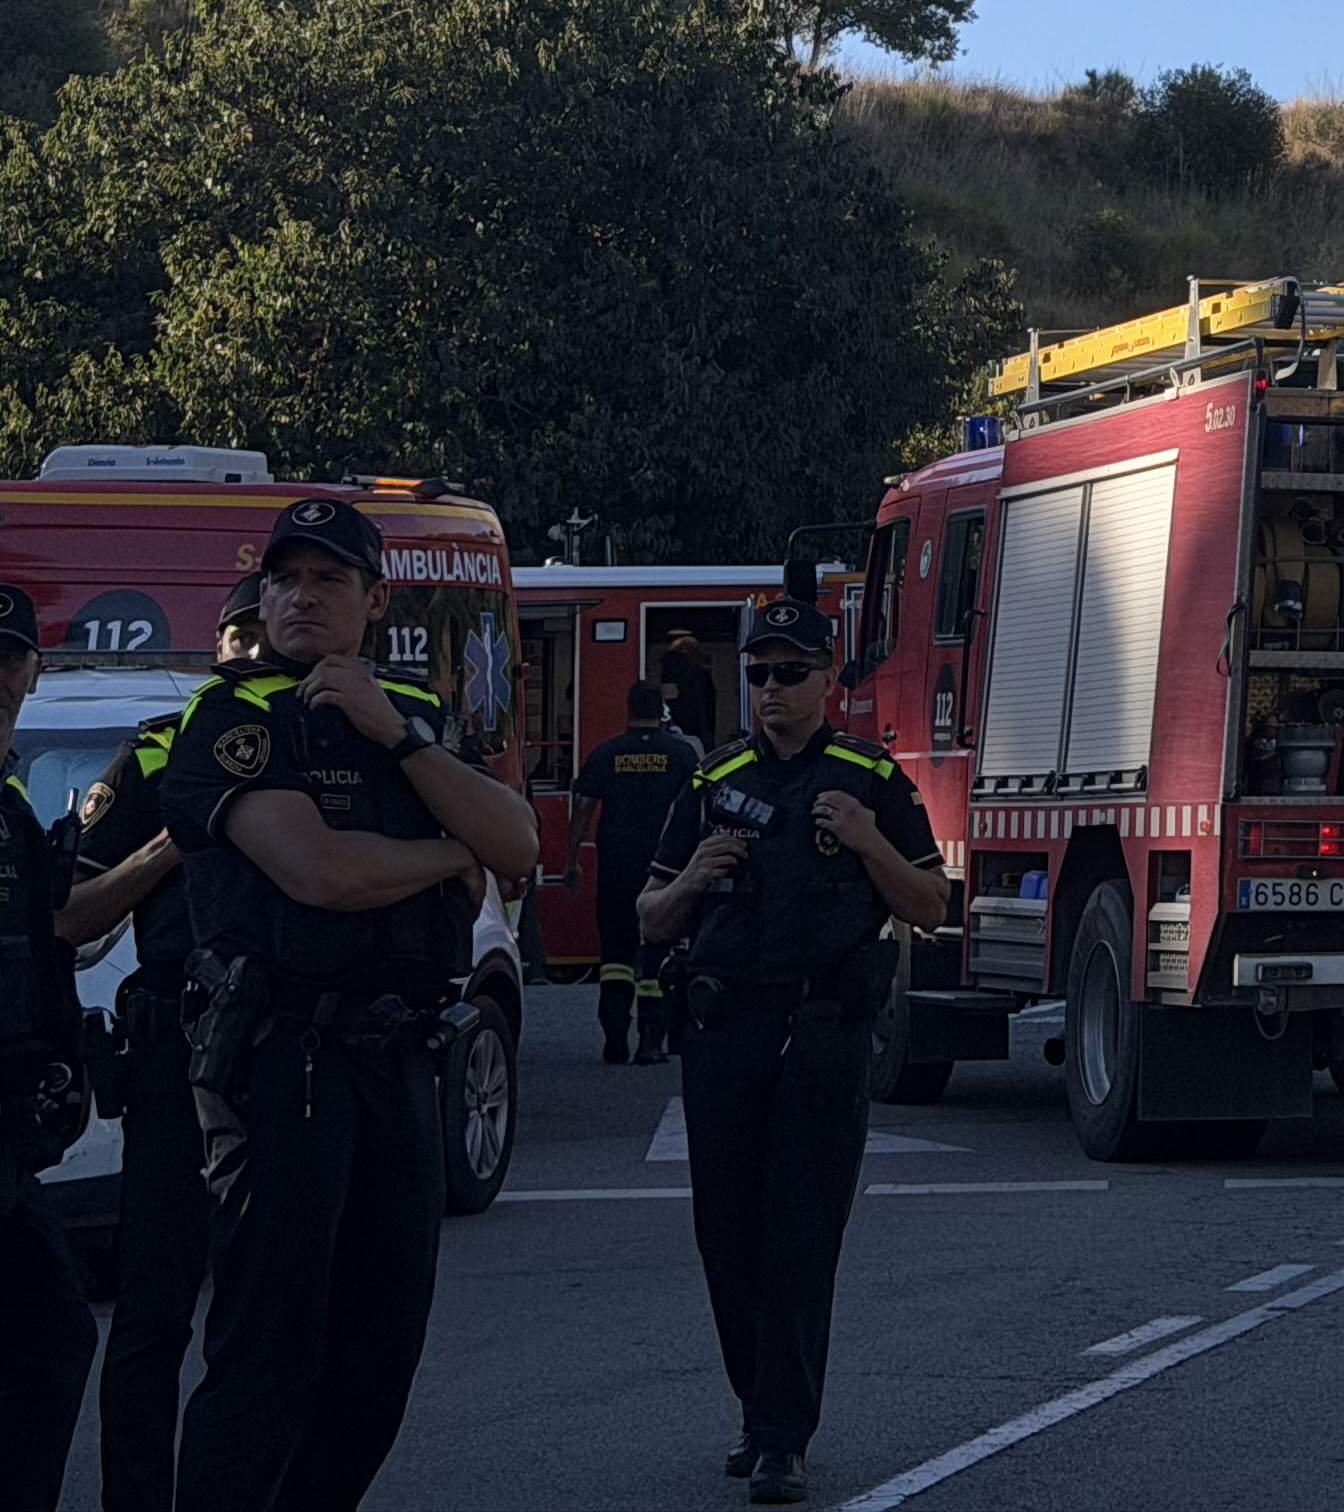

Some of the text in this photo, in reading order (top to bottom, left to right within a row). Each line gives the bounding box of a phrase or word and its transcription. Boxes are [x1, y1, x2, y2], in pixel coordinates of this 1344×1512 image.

[381, 542, 502, 585] AMBULÀNCIA
[84, 619, 153, 651] 112
[387, 626, 429, 662] 112
[934, 691, 954, 727] 112
[1254, 882, 1319, 906] 6586
